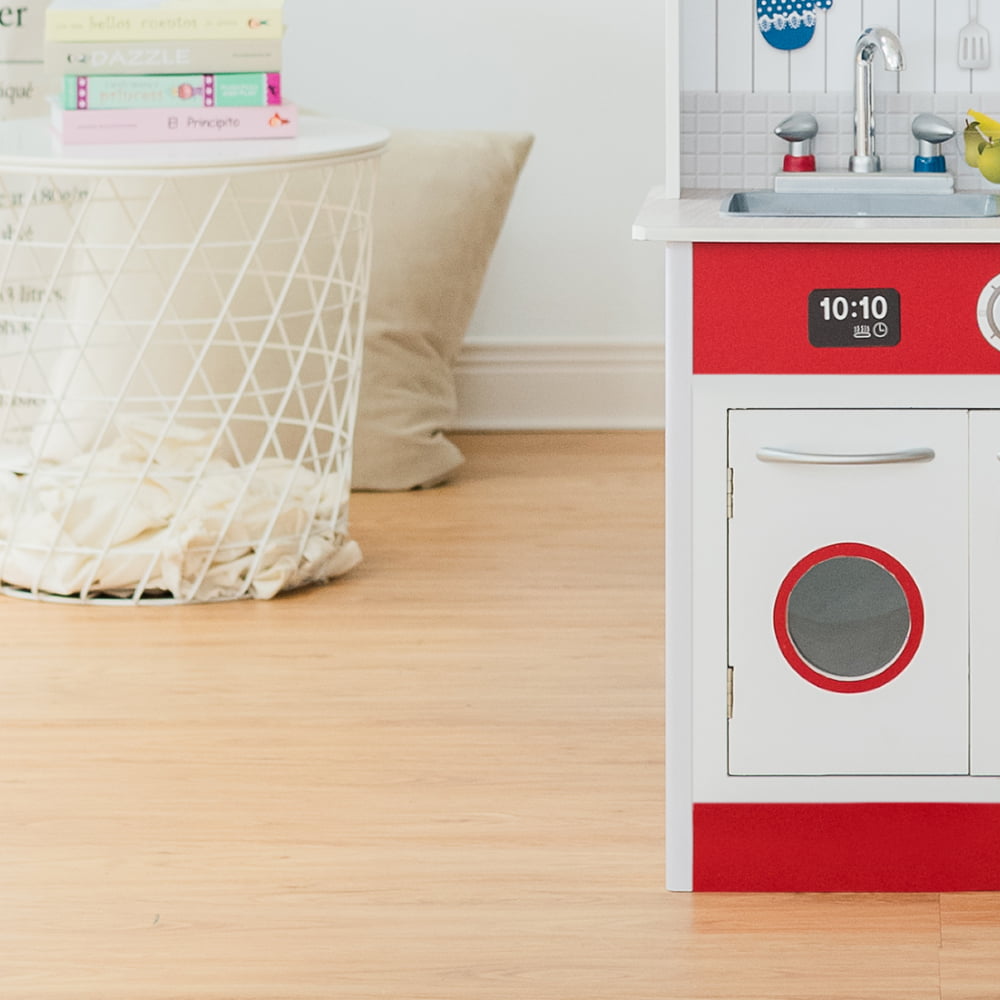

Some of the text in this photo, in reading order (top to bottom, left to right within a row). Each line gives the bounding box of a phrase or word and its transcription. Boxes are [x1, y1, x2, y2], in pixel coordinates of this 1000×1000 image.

[91, 49, 191, 67] DAZZLE
[187, 117, 240, 134] Principito
[820, 295, 888, 320] 10:10
